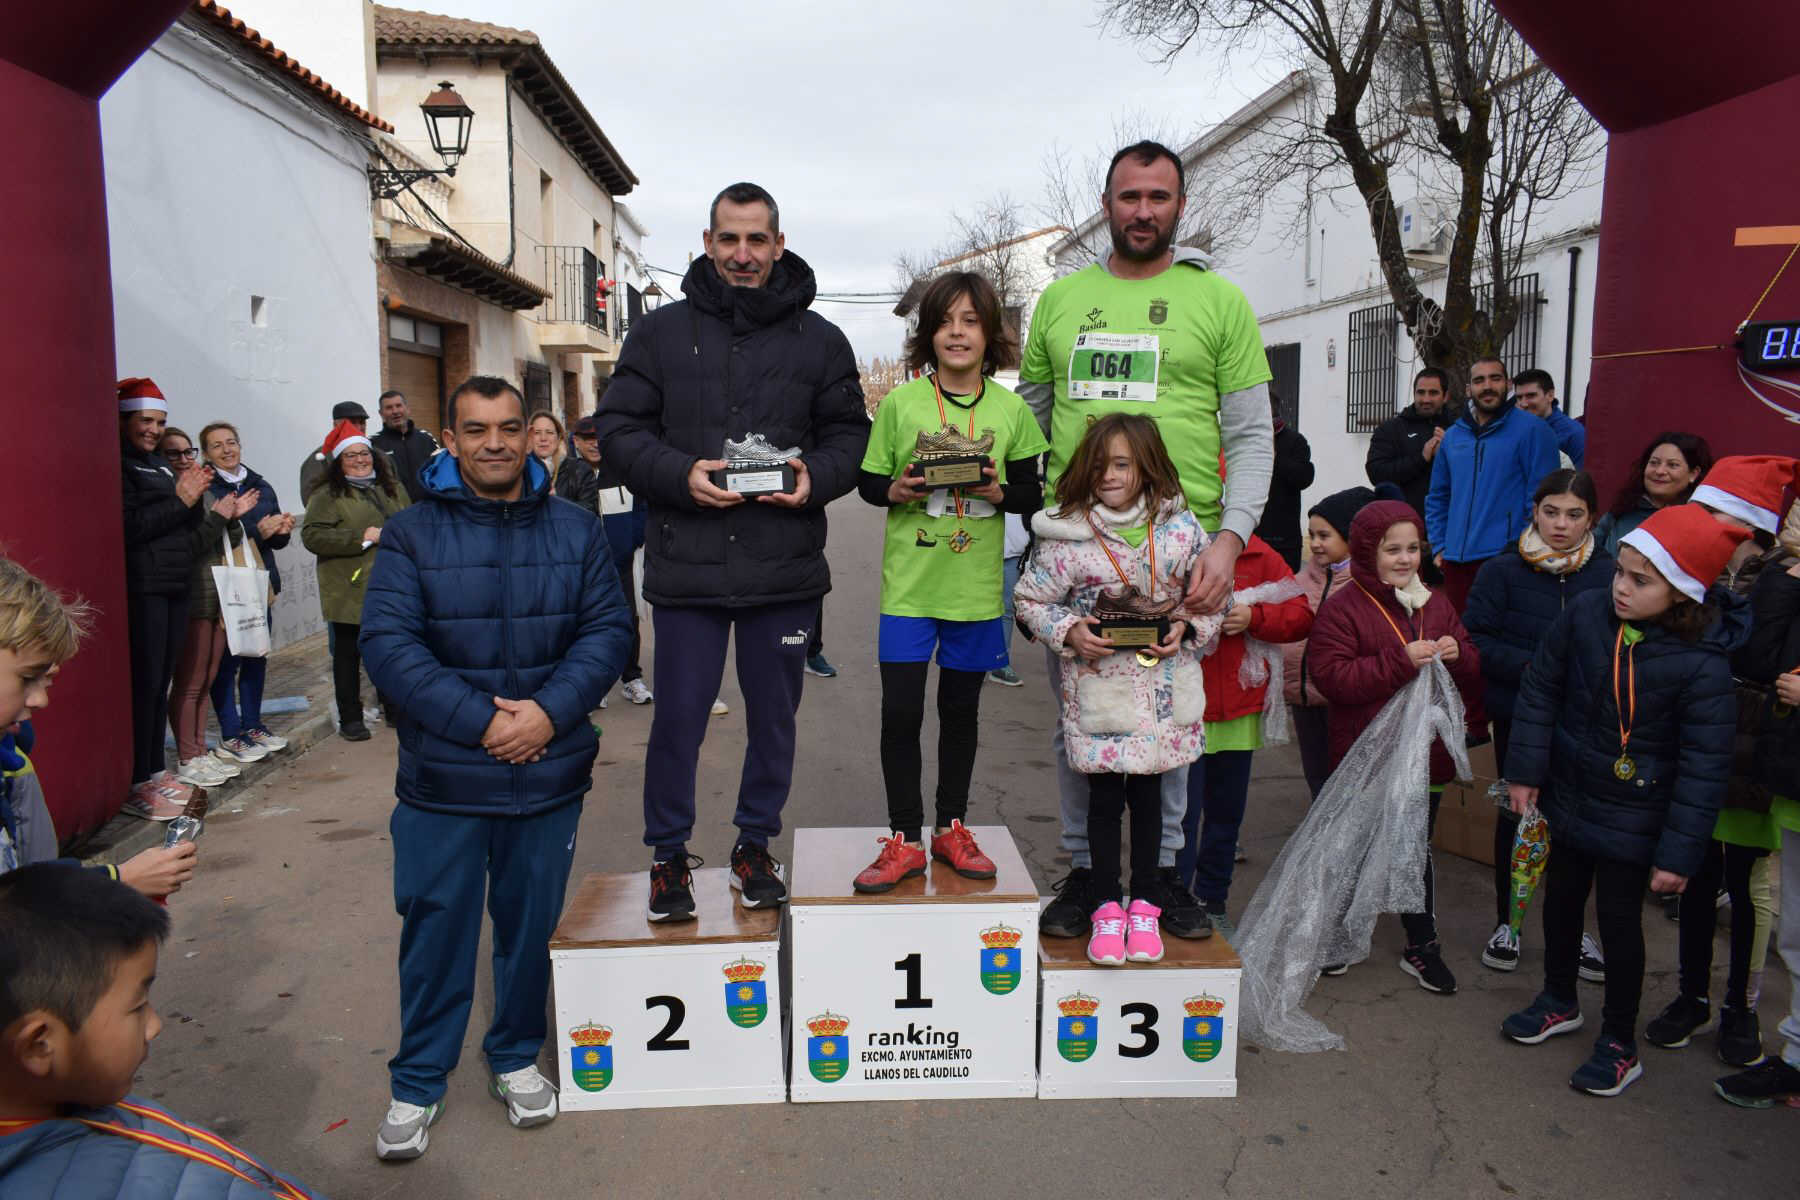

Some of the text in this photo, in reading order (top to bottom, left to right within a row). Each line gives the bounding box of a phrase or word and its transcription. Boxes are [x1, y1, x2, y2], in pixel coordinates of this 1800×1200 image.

[1079, 320, 1108, 333] Basida
[1091, 352, 1132, 379] 064
[782, 636, 805, 645] PUMA
[895, 953, 933, 1008] 1
[646, 995, 690, 1051] 2
[868, 1022, 959, 1048] ranking
[1118, 1002, 1160, 1058] 3
[861, 1049, 972, 1062] EXCMO. AYUNTAMIENTO
[864, 1066, 969, 1080] LLANOS DEL CAUDILLO
